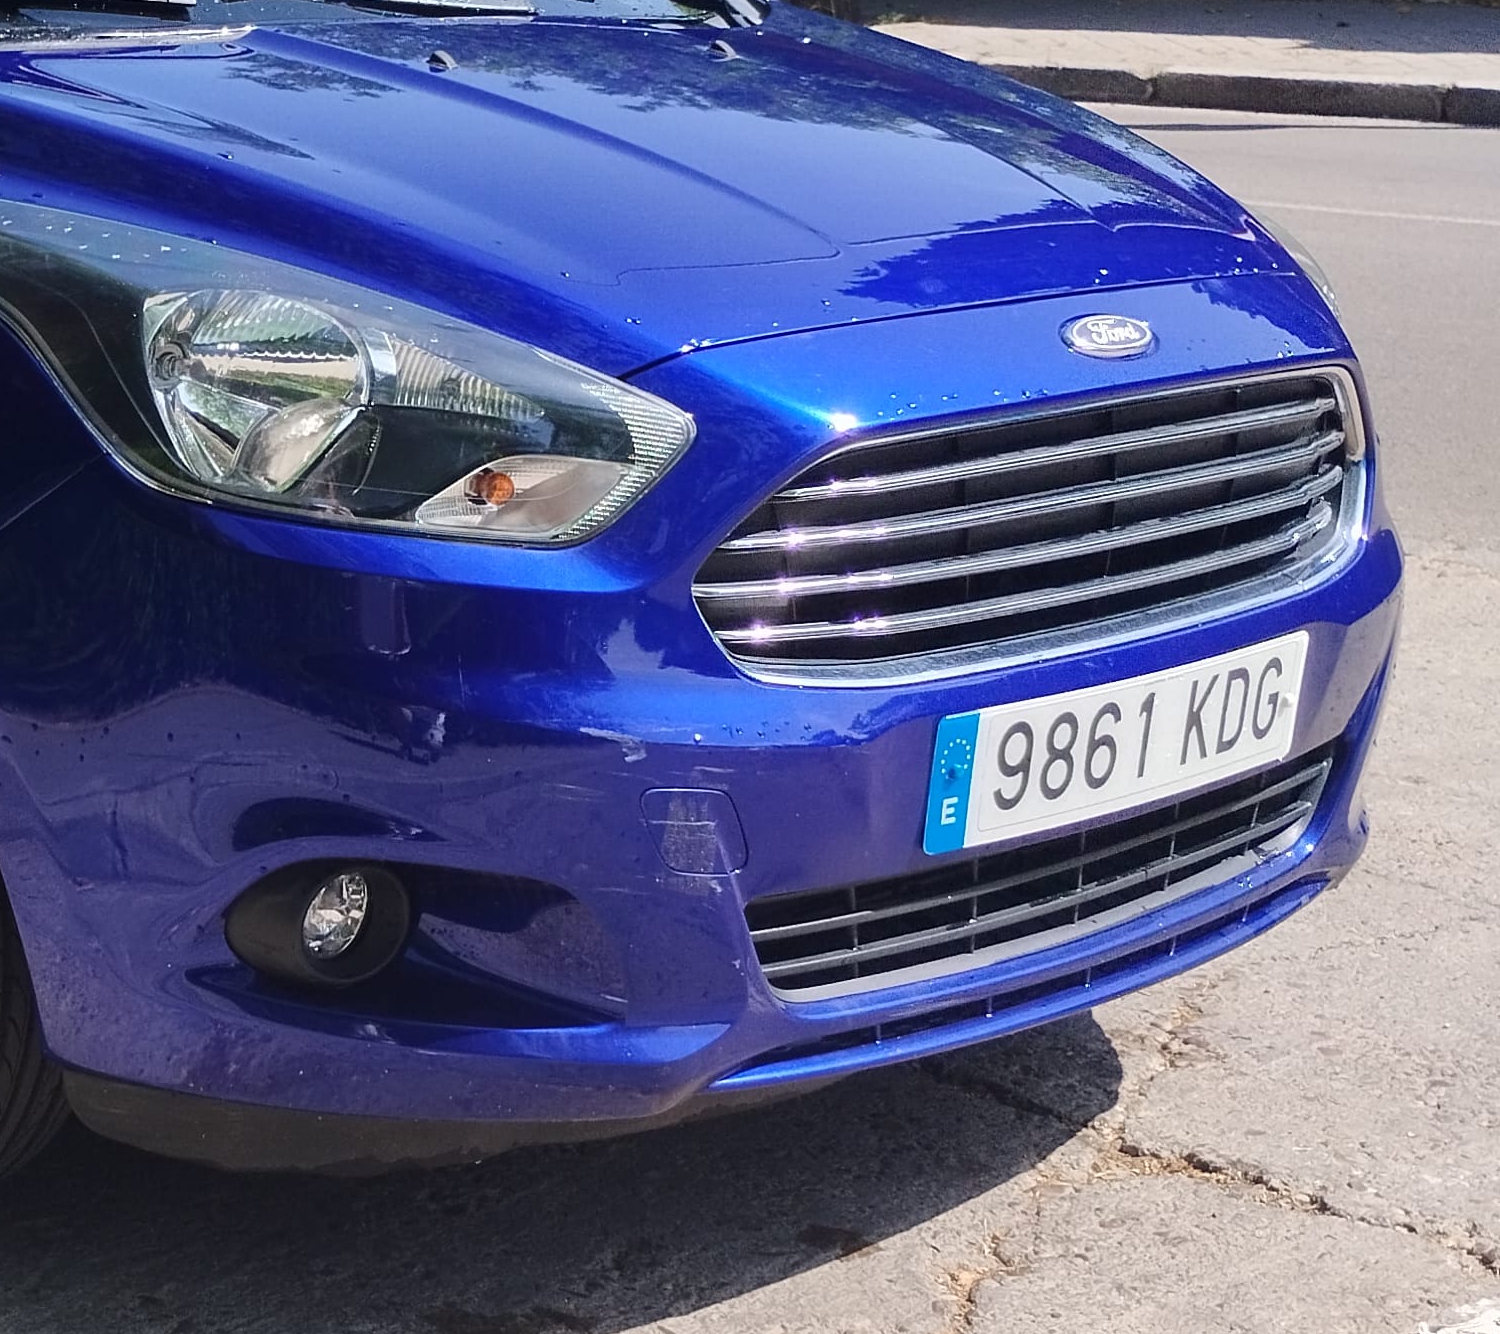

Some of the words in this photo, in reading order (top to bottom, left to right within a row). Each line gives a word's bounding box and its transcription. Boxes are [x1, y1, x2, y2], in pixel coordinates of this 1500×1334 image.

[1087, 319, 1140, 345] Ford
[993, 692, 1156, 811] 9861
[1180, 657, 1283, 766] KDG
[940, 796, 959, 826] E
